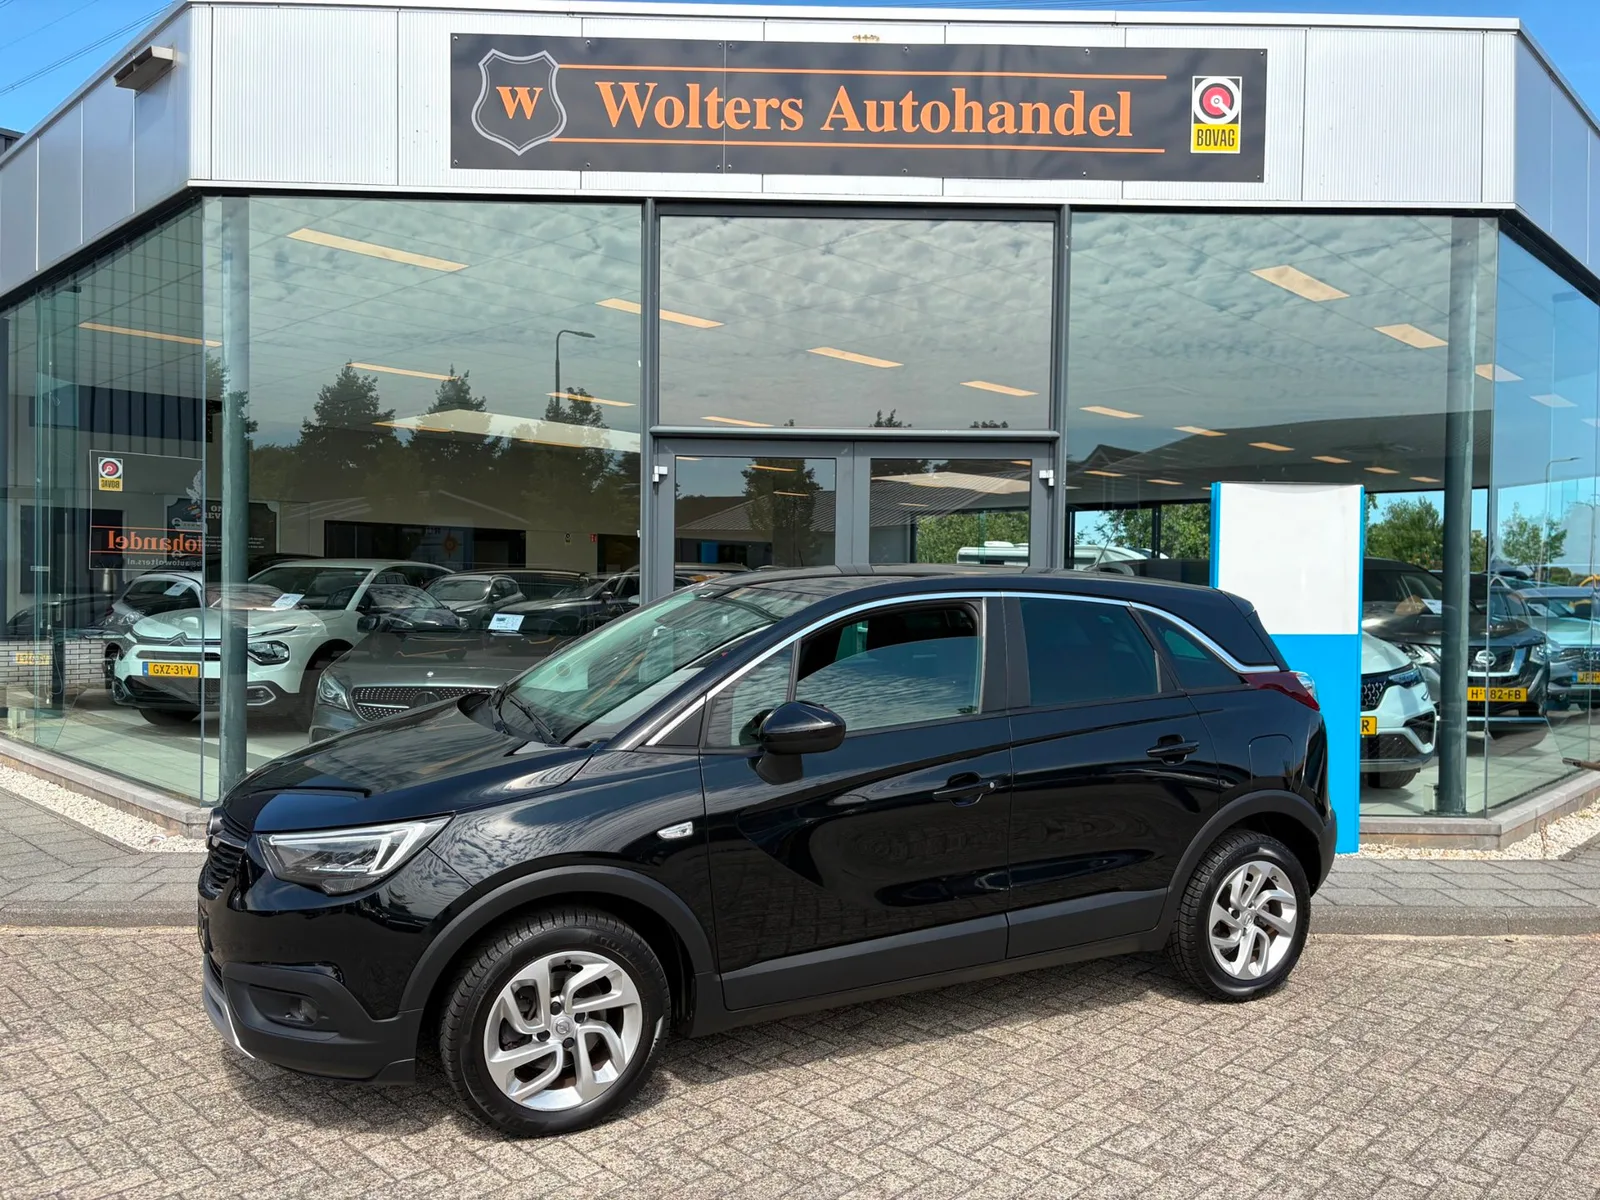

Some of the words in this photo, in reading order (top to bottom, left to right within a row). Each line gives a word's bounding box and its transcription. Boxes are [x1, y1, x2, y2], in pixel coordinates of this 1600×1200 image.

[496, 86, 542, 120] W
[595, 81, 804, 131] Wolters
[821, 87, 1132, 137] Autohandel
[1197, 128, 1235, 147] BOVAG
[153, 664, 192, 675] GXZ-31-V
